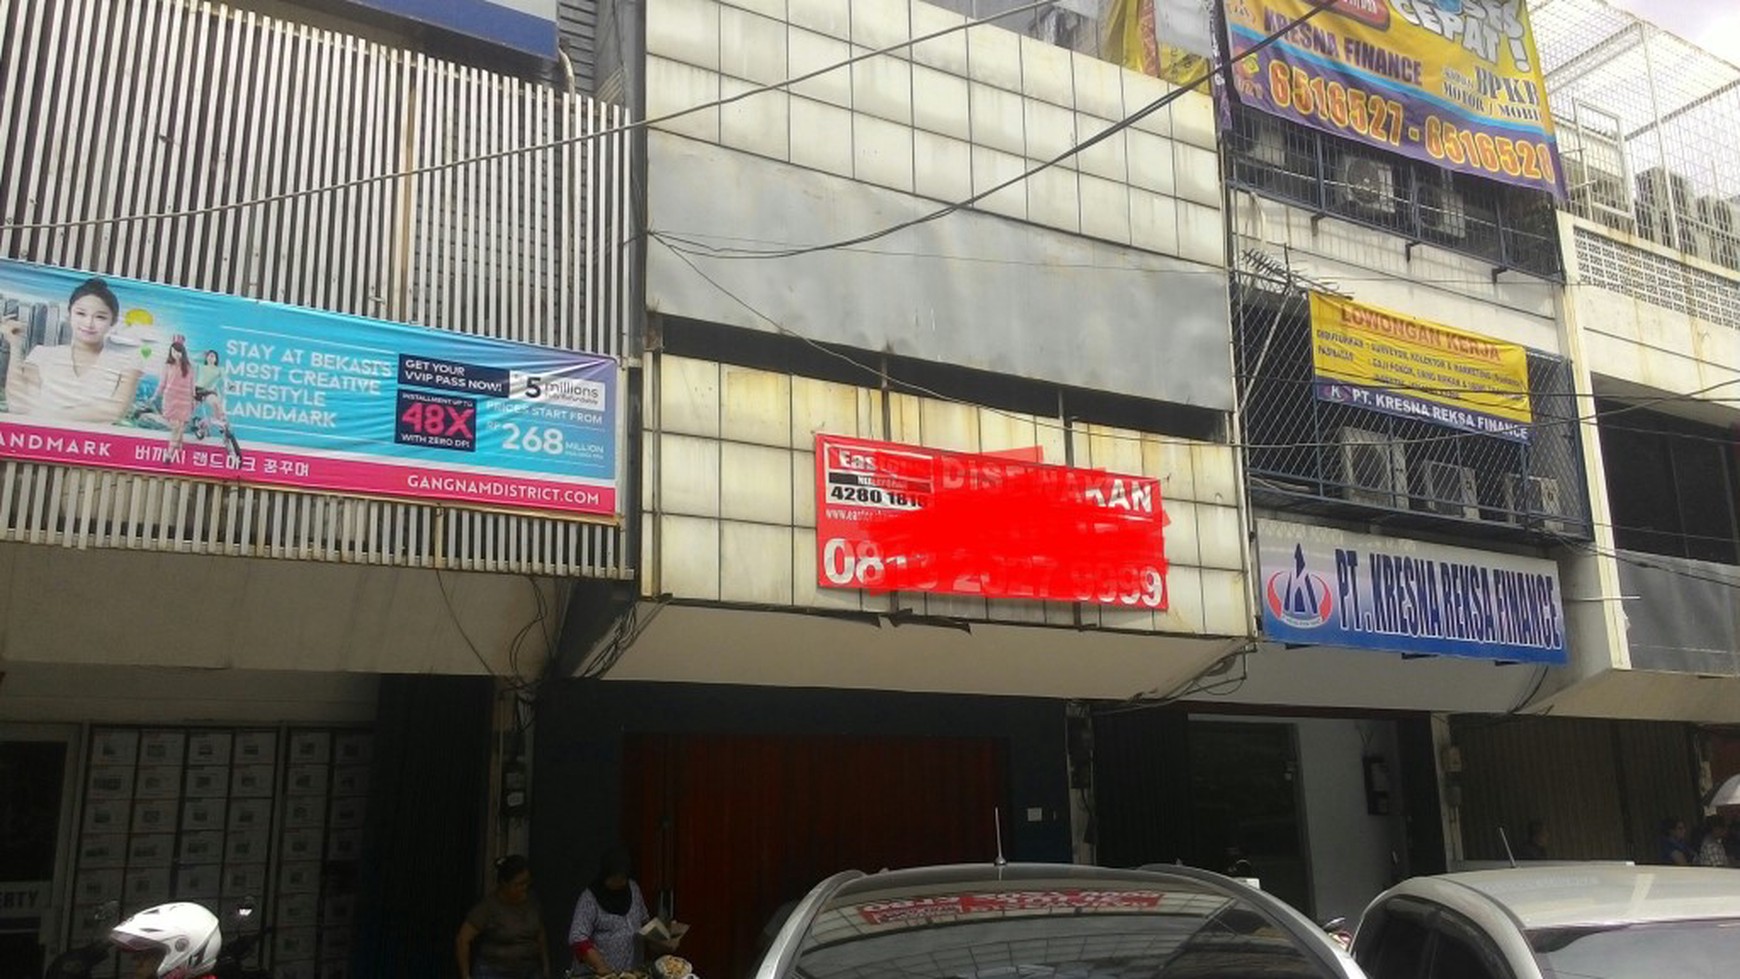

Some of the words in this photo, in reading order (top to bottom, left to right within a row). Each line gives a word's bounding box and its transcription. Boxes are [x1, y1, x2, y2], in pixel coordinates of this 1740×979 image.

[1264, 6, 1340, 58] KRESNA
[1344, 37, 1424, 86] FINANCE
[1269, 59, 1403, 147] 6516527
[1340, 307, 1441, 348] LOWONGAN
[1446, 331, 1502, 362] KERJA
[226, 339, 275, 360] STAY
[281, 348, 304, 364] AT
[225, 360, 282, 381] MOST
[288, 369, 382, 396] CREATIVE
[405, 359, 430, 371] GET
[433, 363, 465, 376] YOUR
[405, 371, 433, 383] VVIP
[435, 375, 466, 388] PASS
[468, 380, 502, 392] NOW!
[224, 379, 327, 407] LIFESTYLE
[525, 377, 541, 398] 5
[222, 400, 338, 428] LANDMARK
[402, 402, 475, 440] 48X
[486, 401, 529, 414] PRICES
[532, 407, 567, 420] START
[570, 412, 603, 424] FROM
[1352, 388, 1372, 405] PT.
[1376, 393, 1430, 417] KRESNA
[1433, 408, 1476, 428] REKSA
[1478, 416, 1529, 440] FINANCE
[401, 433, 427, 442] WITH
[428, 436, 453, 446] ZERO
[502, 422, 564, 455] 268
[407, 474, 599, 505] GANGNAMDISTRICT.COM
[830, 485, 882, 504] 4280
[1369, 553, 1444, 639] KRESNA
[1440, 562, 1497, 644] REKSA
[1493, 569, 1562, 650] FINANCE
